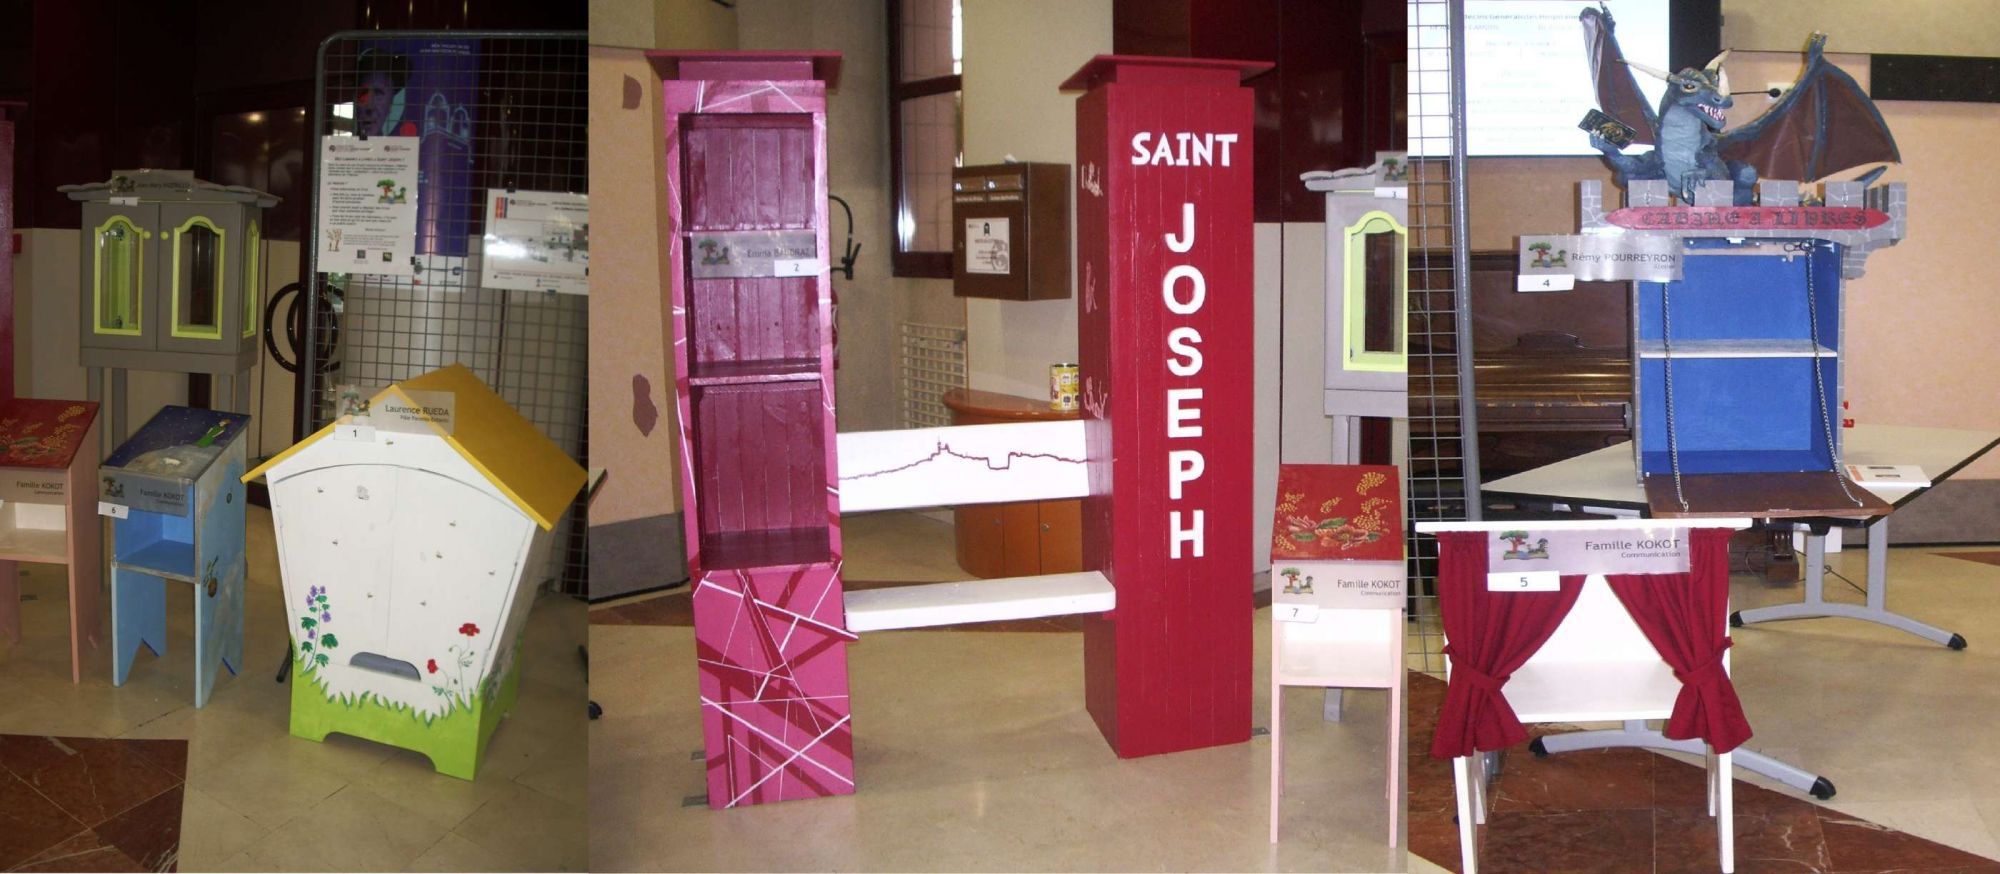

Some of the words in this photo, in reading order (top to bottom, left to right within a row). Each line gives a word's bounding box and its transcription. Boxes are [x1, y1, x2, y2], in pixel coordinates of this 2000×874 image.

[1131, 132, 1238, 167] SAINT
[1572, 252, 1600, 263] Rémy
[1604, 253, 1676, 262] POURREYRON
[793, 263, 800, 272] 2
[1542, 279, 1550, 287] 4
[1162, 202, 1206, 560] JOSEPH
[385, 404, 420, 415] Laurence
[423, 406, 449, 417] RUEDA
[353, 428, 357, 438] 1
[16, 480, 40, 489] Famille
[41, 482, 64, 490] KOKOT
[140, 488, 162, 498] Famille
[1585, 541, 1632, 550] Famille
[1637, 539, 1681, 549] KOKOT
[1337, 579, 1369, 588] Famille
[1371, 580, 1401, 589] KOKOT
[1520, 577, 1528, 587] 5
[1292, 608, 1299, 617] 7
